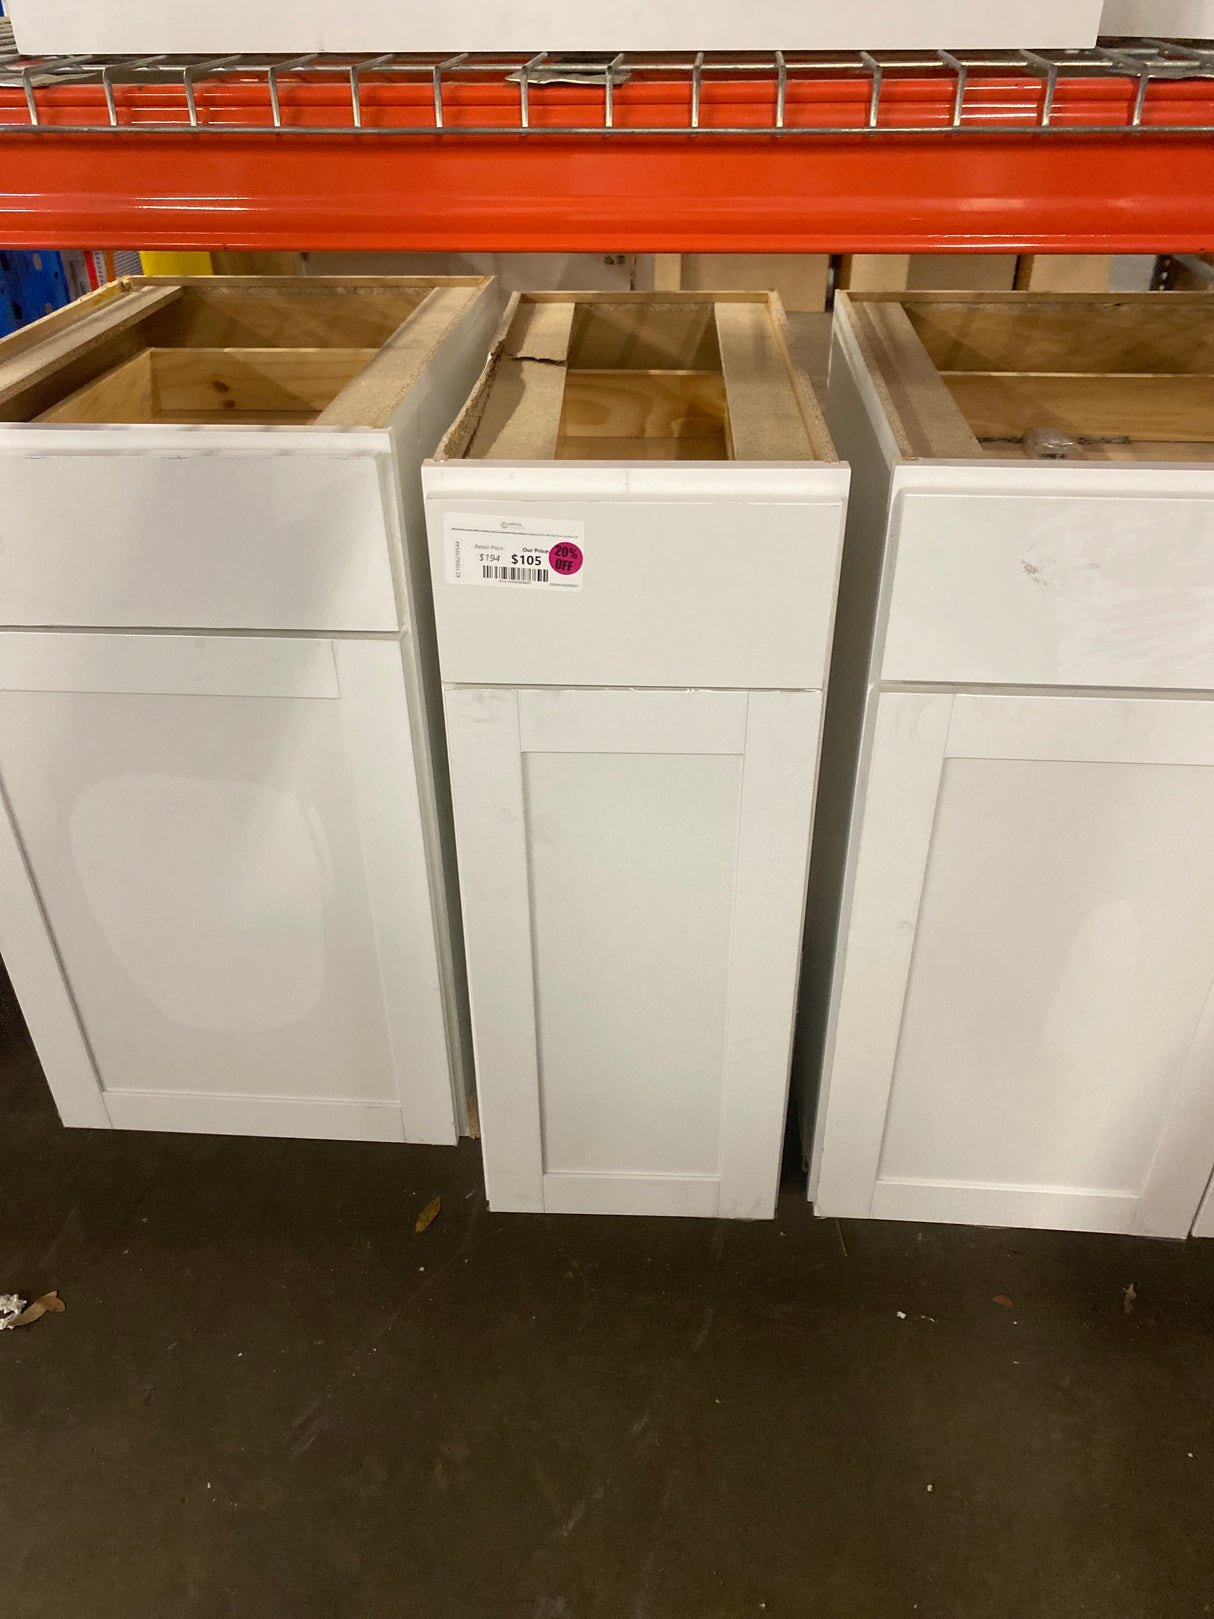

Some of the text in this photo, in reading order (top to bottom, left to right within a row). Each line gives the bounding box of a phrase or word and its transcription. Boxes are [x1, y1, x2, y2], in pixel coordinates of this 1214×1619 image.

[479, 554, 501, 562] $194
[554, 545, 578, 560] 20%
[511, 553, 542, 566] $105
[555, 559, 574, 571] OFF
